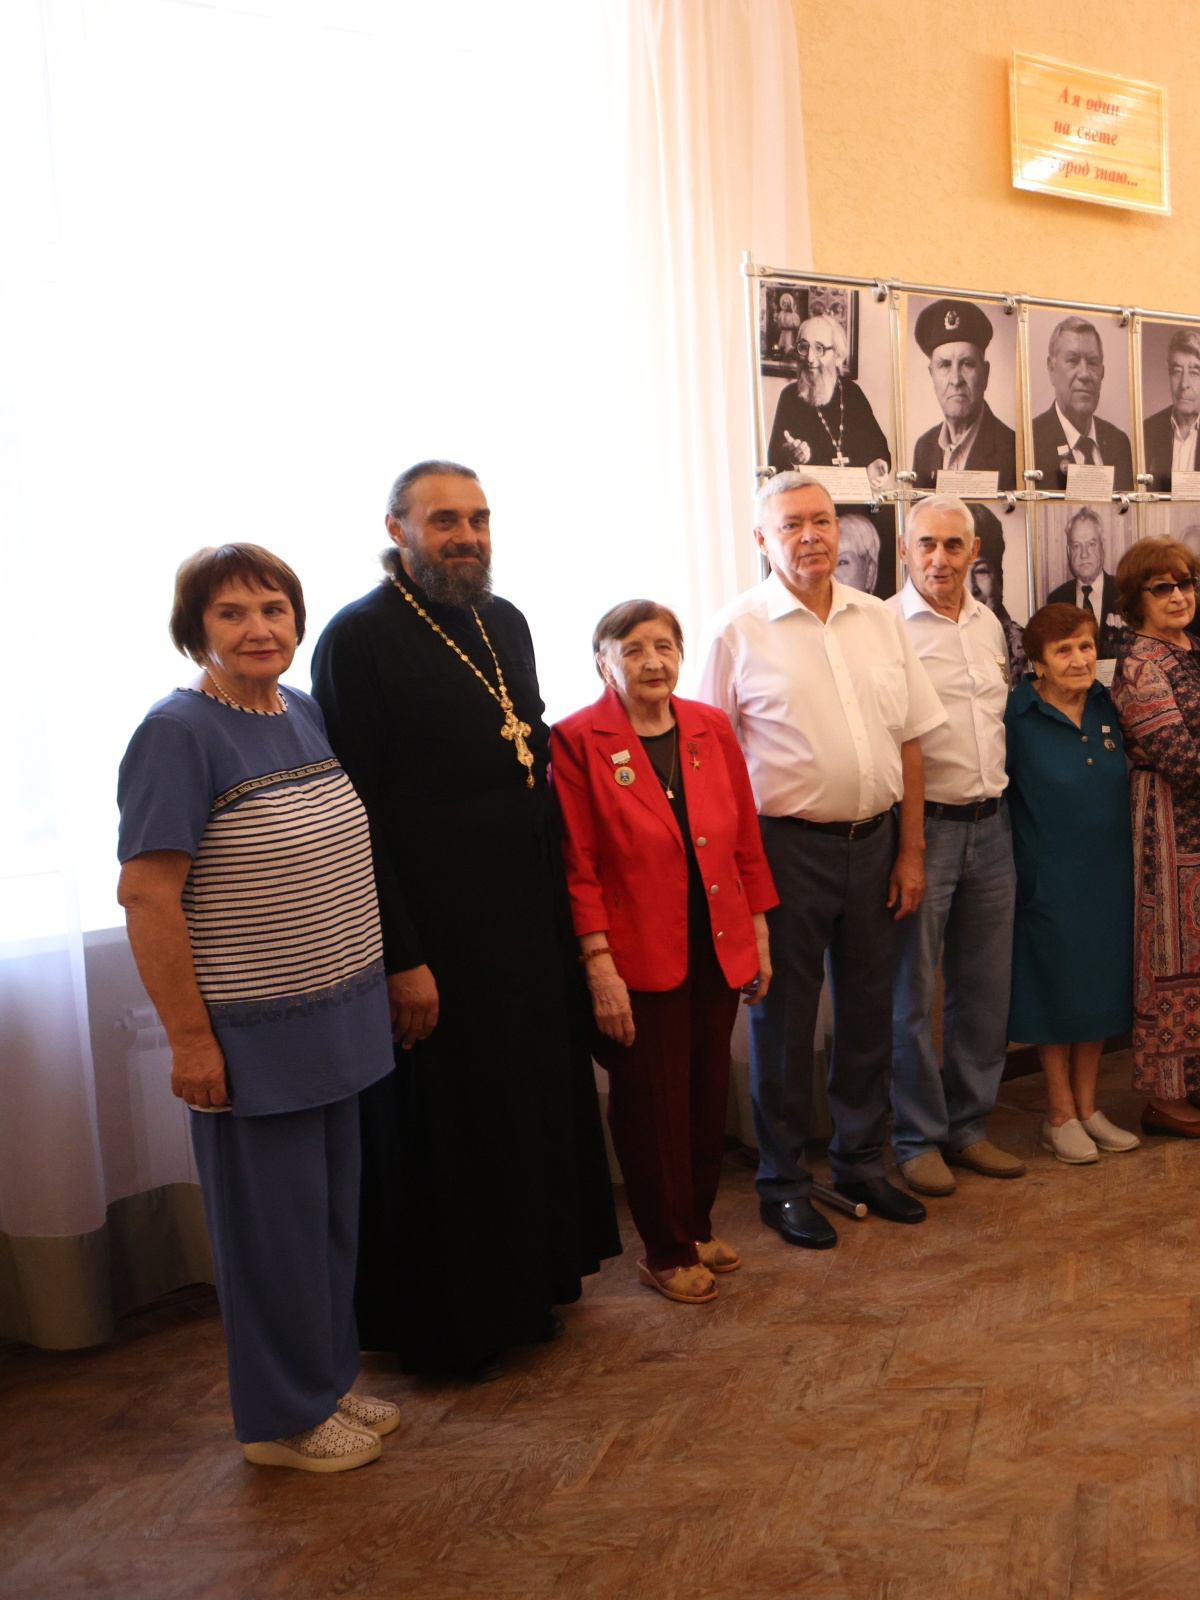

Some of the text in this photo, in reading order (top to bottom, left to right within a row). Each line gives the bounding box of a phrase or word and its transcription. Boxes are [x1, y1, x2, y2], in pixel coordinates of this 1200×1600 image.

[1058, 86, 1119, 116] А я один
[1054, 120, 1118, 146] на свете
[1094, 166, 1138, 187] знаю...
